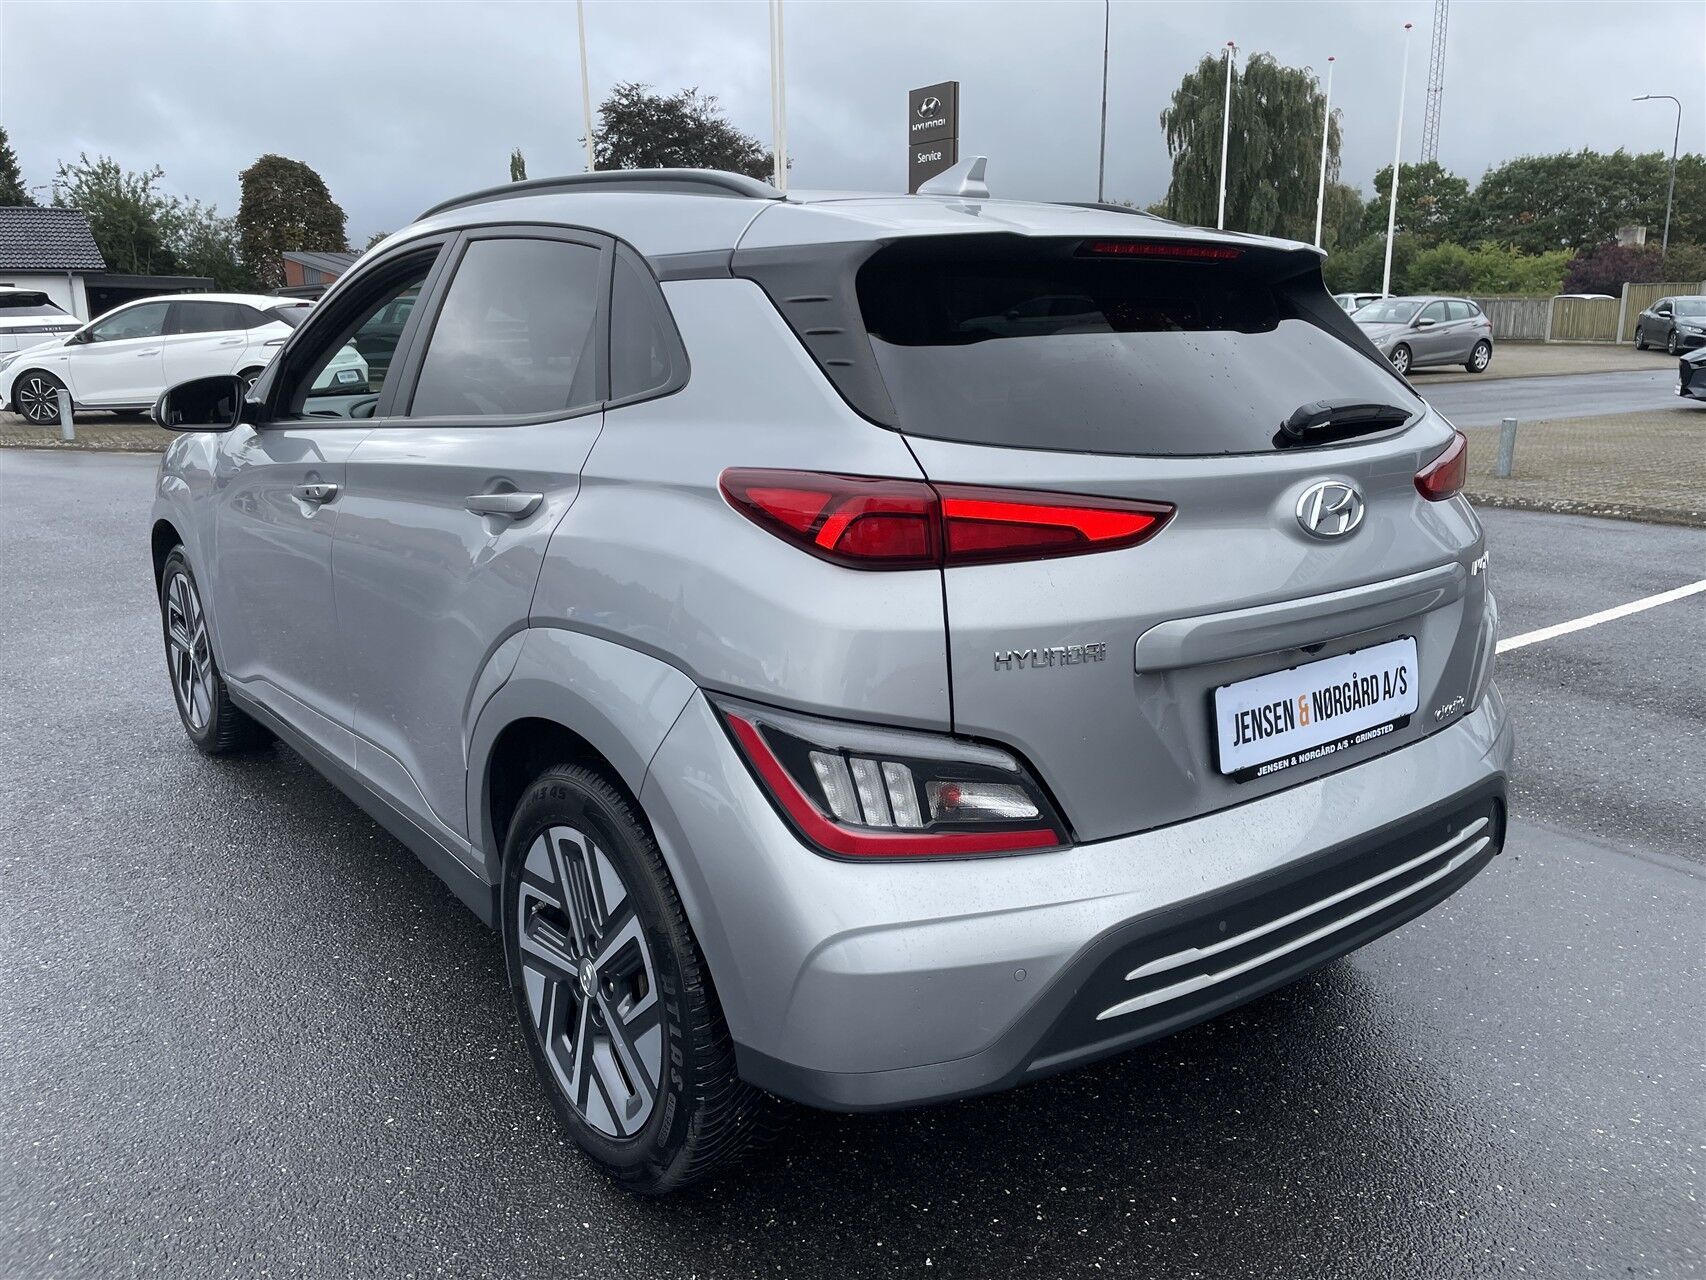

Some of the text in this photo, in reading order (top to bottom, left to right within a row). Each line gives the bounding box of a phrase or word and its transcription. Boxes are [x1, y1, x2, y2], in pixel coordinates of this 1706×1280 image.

[912, 118, 946, 131] HYUNDAI
[917, 150, 942, 163] Service
[994, 641, 1106, 671] HYUNDAI
[1233, 665, 1408, 747] JENSEN & NØRGÅRD A/S
[1256, 758, 1289, 777] JENSEN
[1298, 744, 1336, 764] NØRGÅRD
[1336, 739, 1349, 751] A/S
[1355, 723, 1394, 744] GRINDSTED
